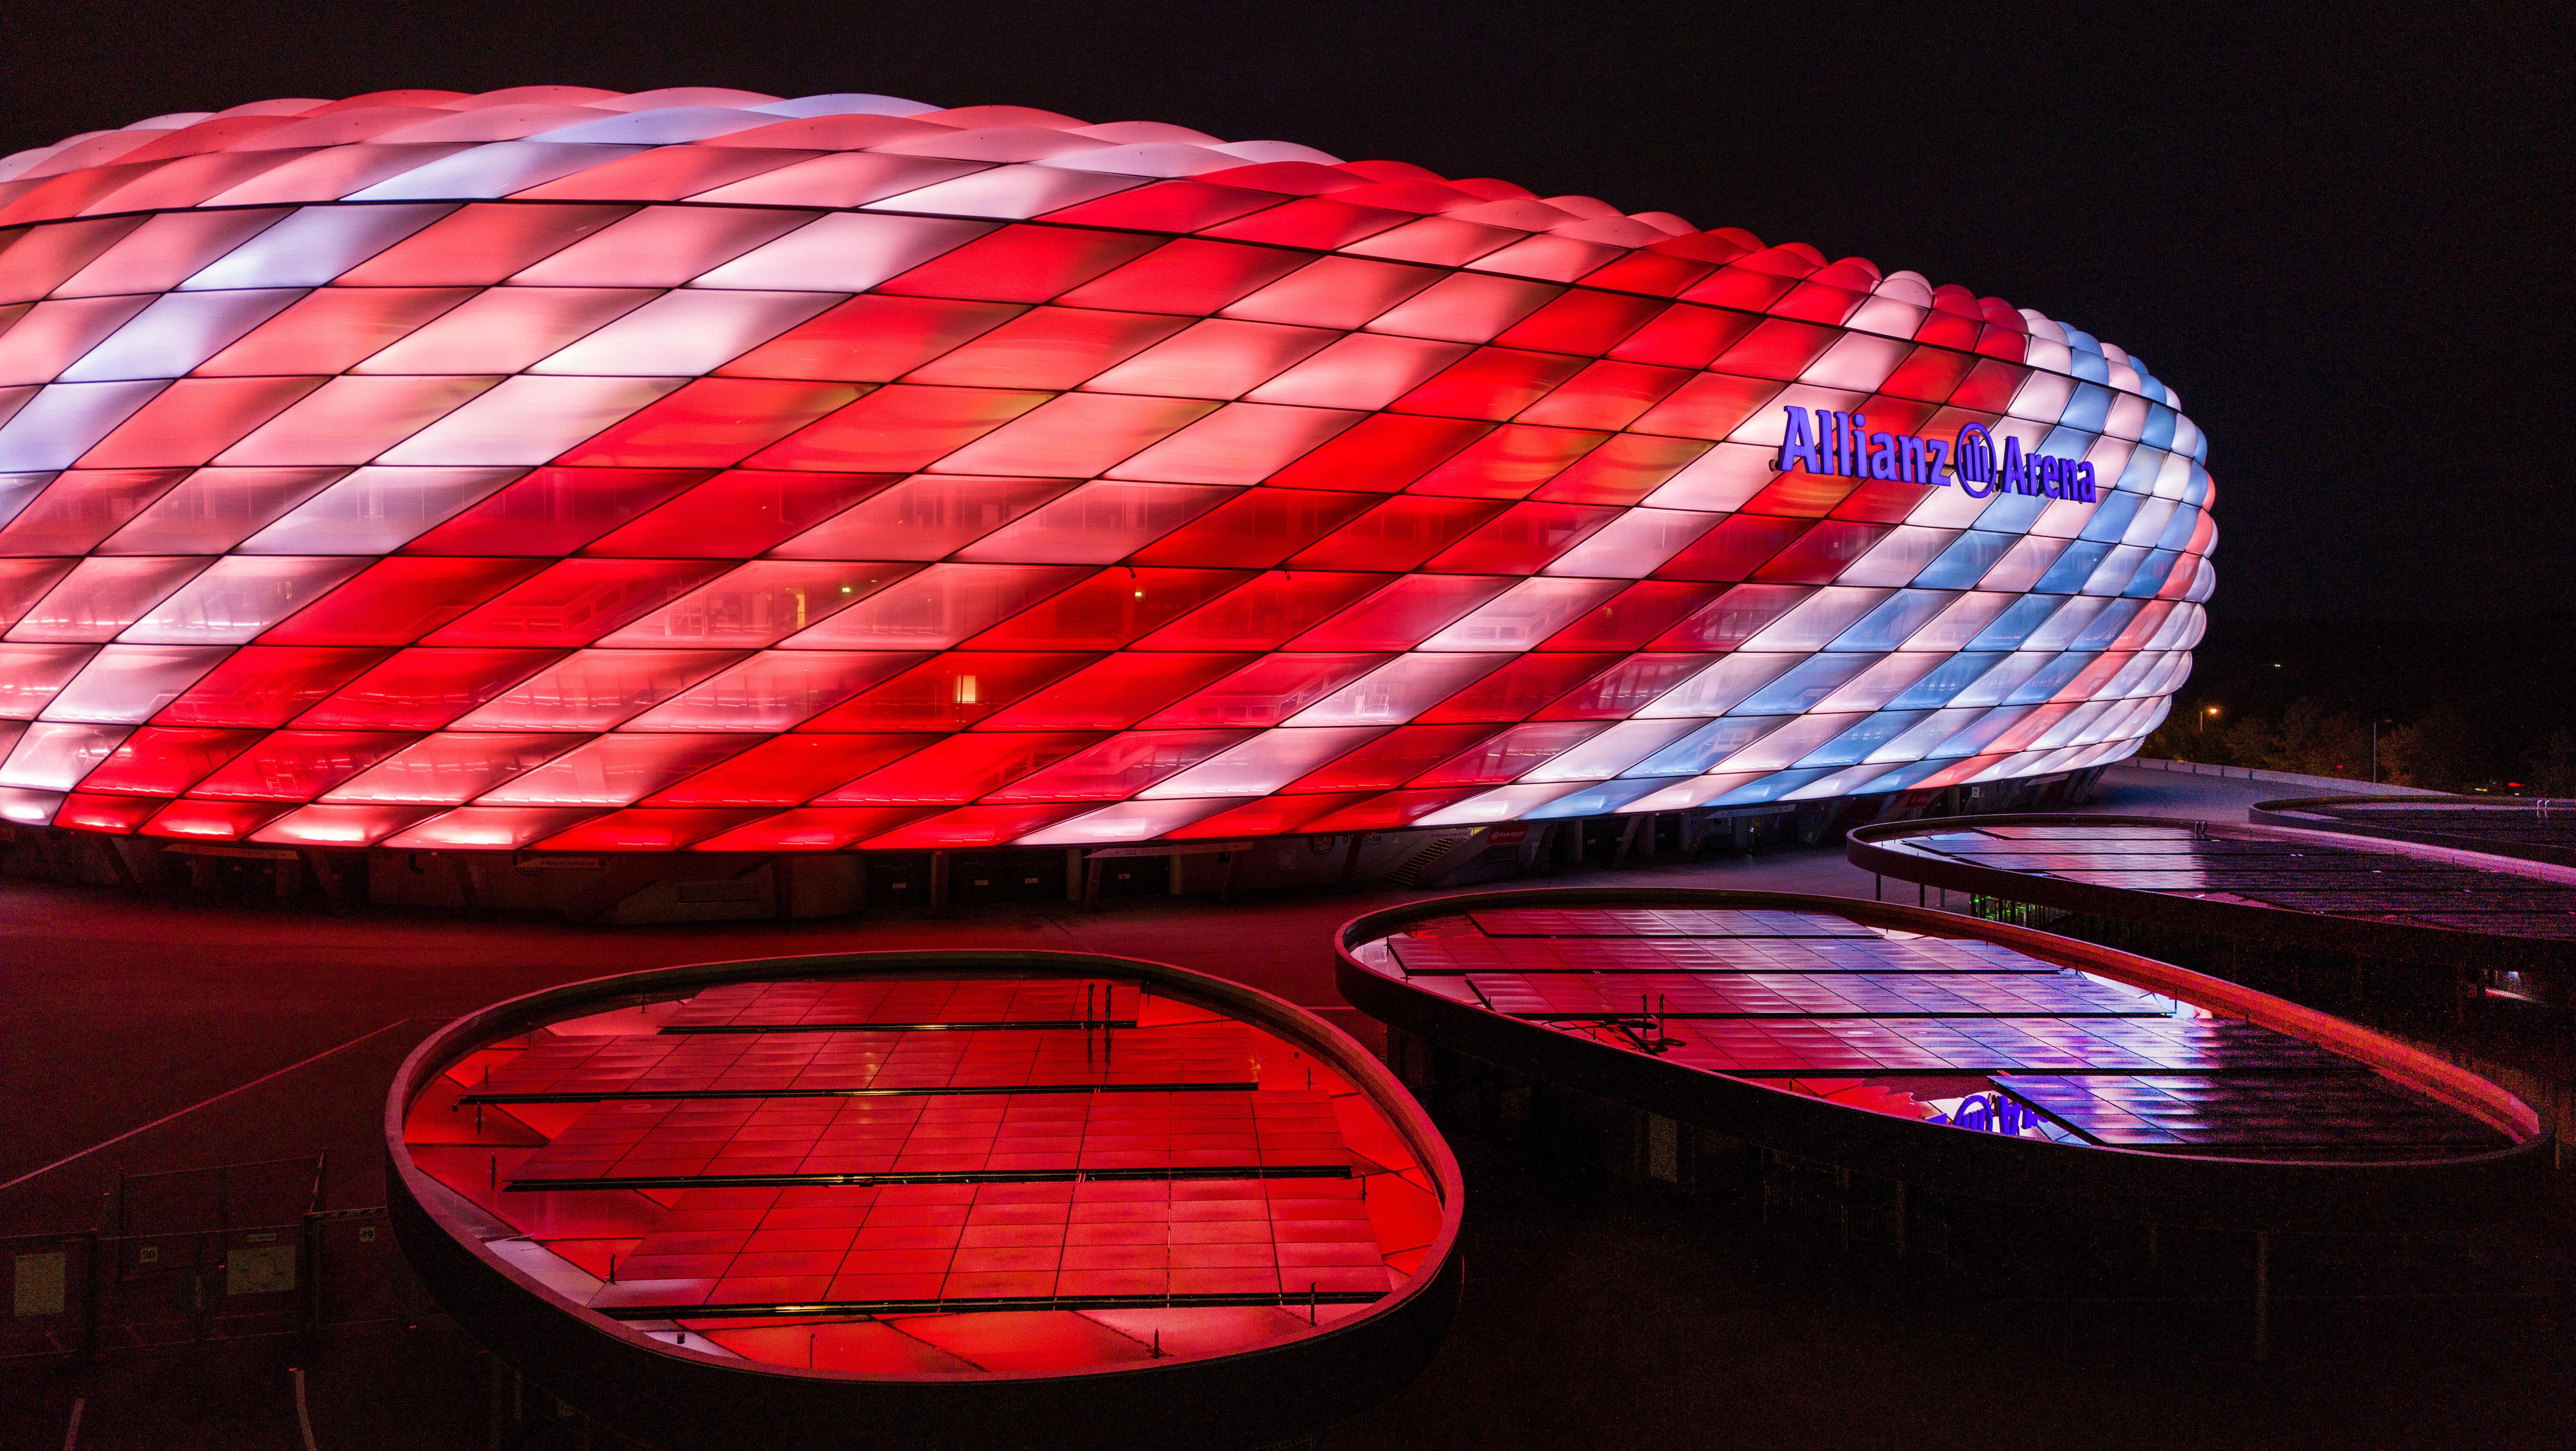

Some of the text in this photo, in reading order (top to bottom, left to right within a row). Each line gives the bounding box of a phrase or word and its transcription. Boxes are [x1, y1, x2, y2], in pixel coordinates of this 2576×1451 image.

[1780, 405, 2097, 504] Allianz Arena
[361, 1230, 373, 1239] 49
[143, 1250, 155, 1259] 50
